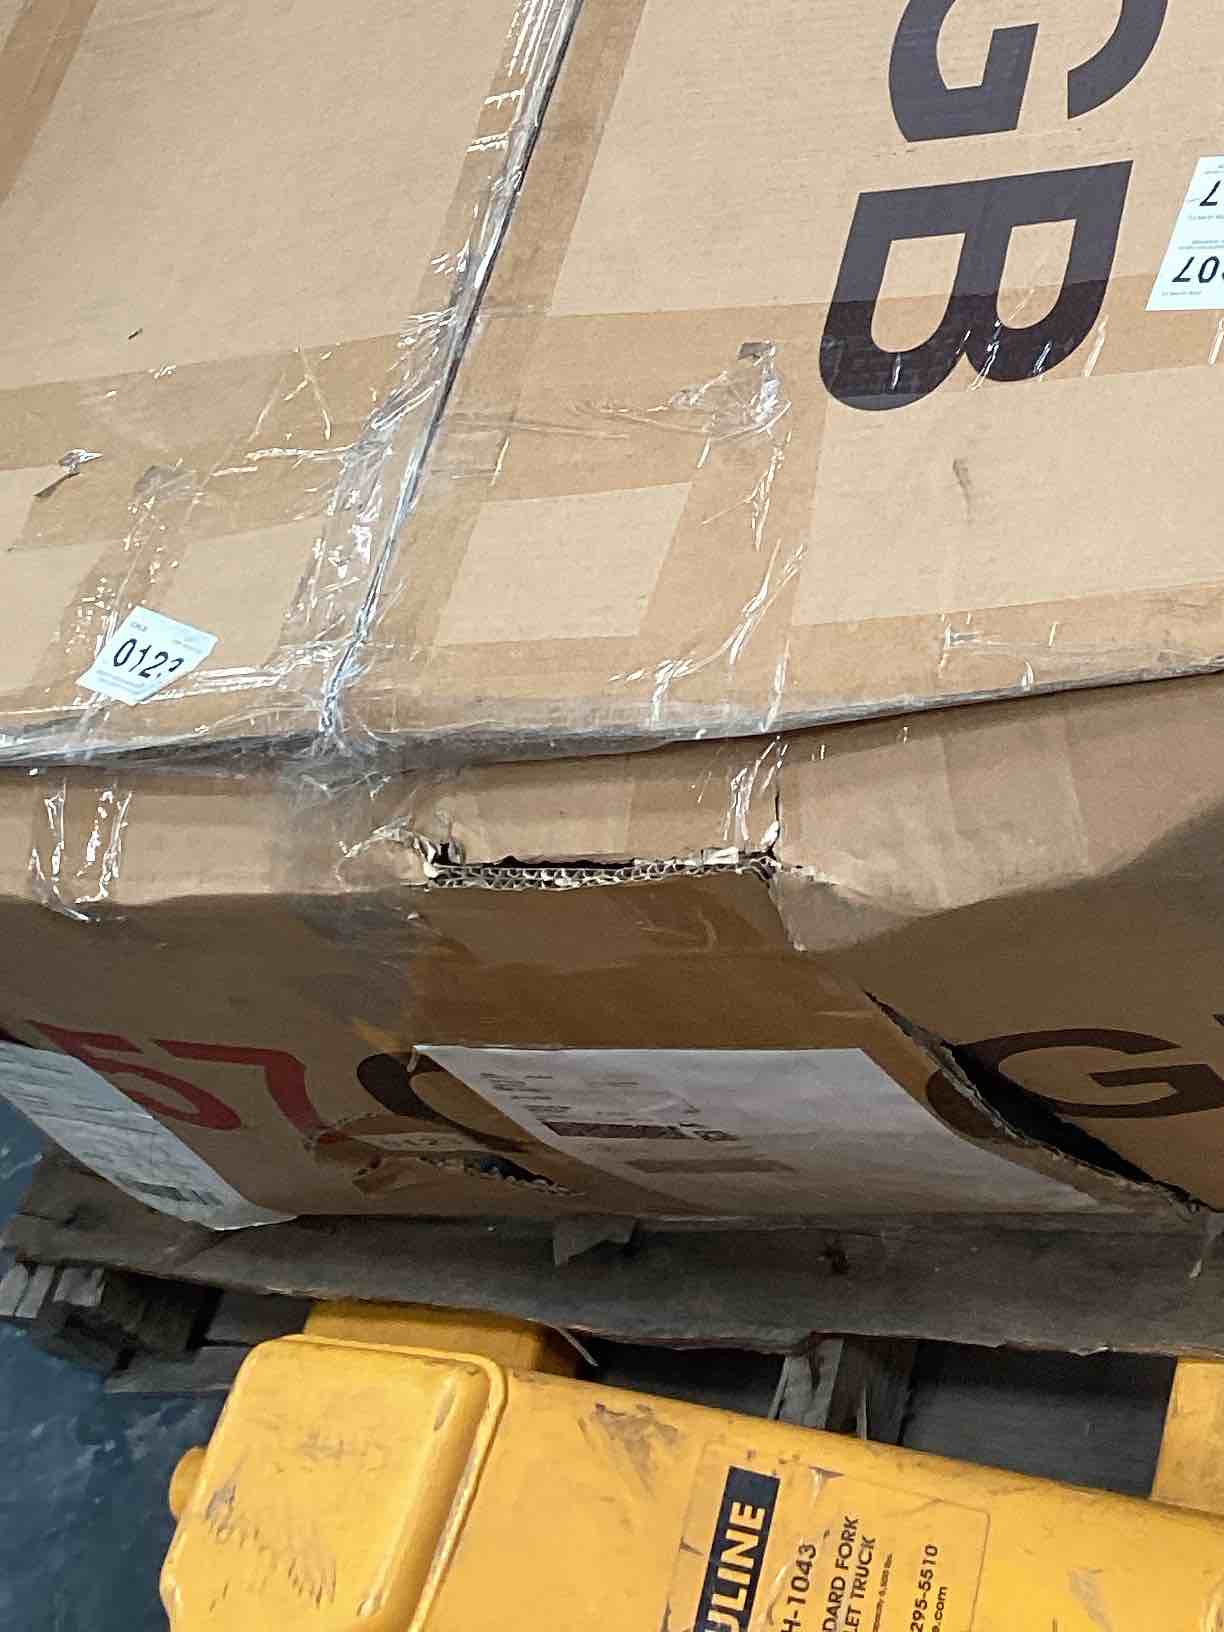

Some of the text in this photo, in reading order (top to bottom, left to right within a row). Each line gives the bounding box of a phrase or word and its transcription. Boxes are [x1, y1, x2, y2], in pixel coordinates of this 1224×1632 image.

[704, 1502, 766, 1632] ULINE
[835, 1515, 859, 1571] FORK
[850, 1535, 876, 1599] TRUCK
